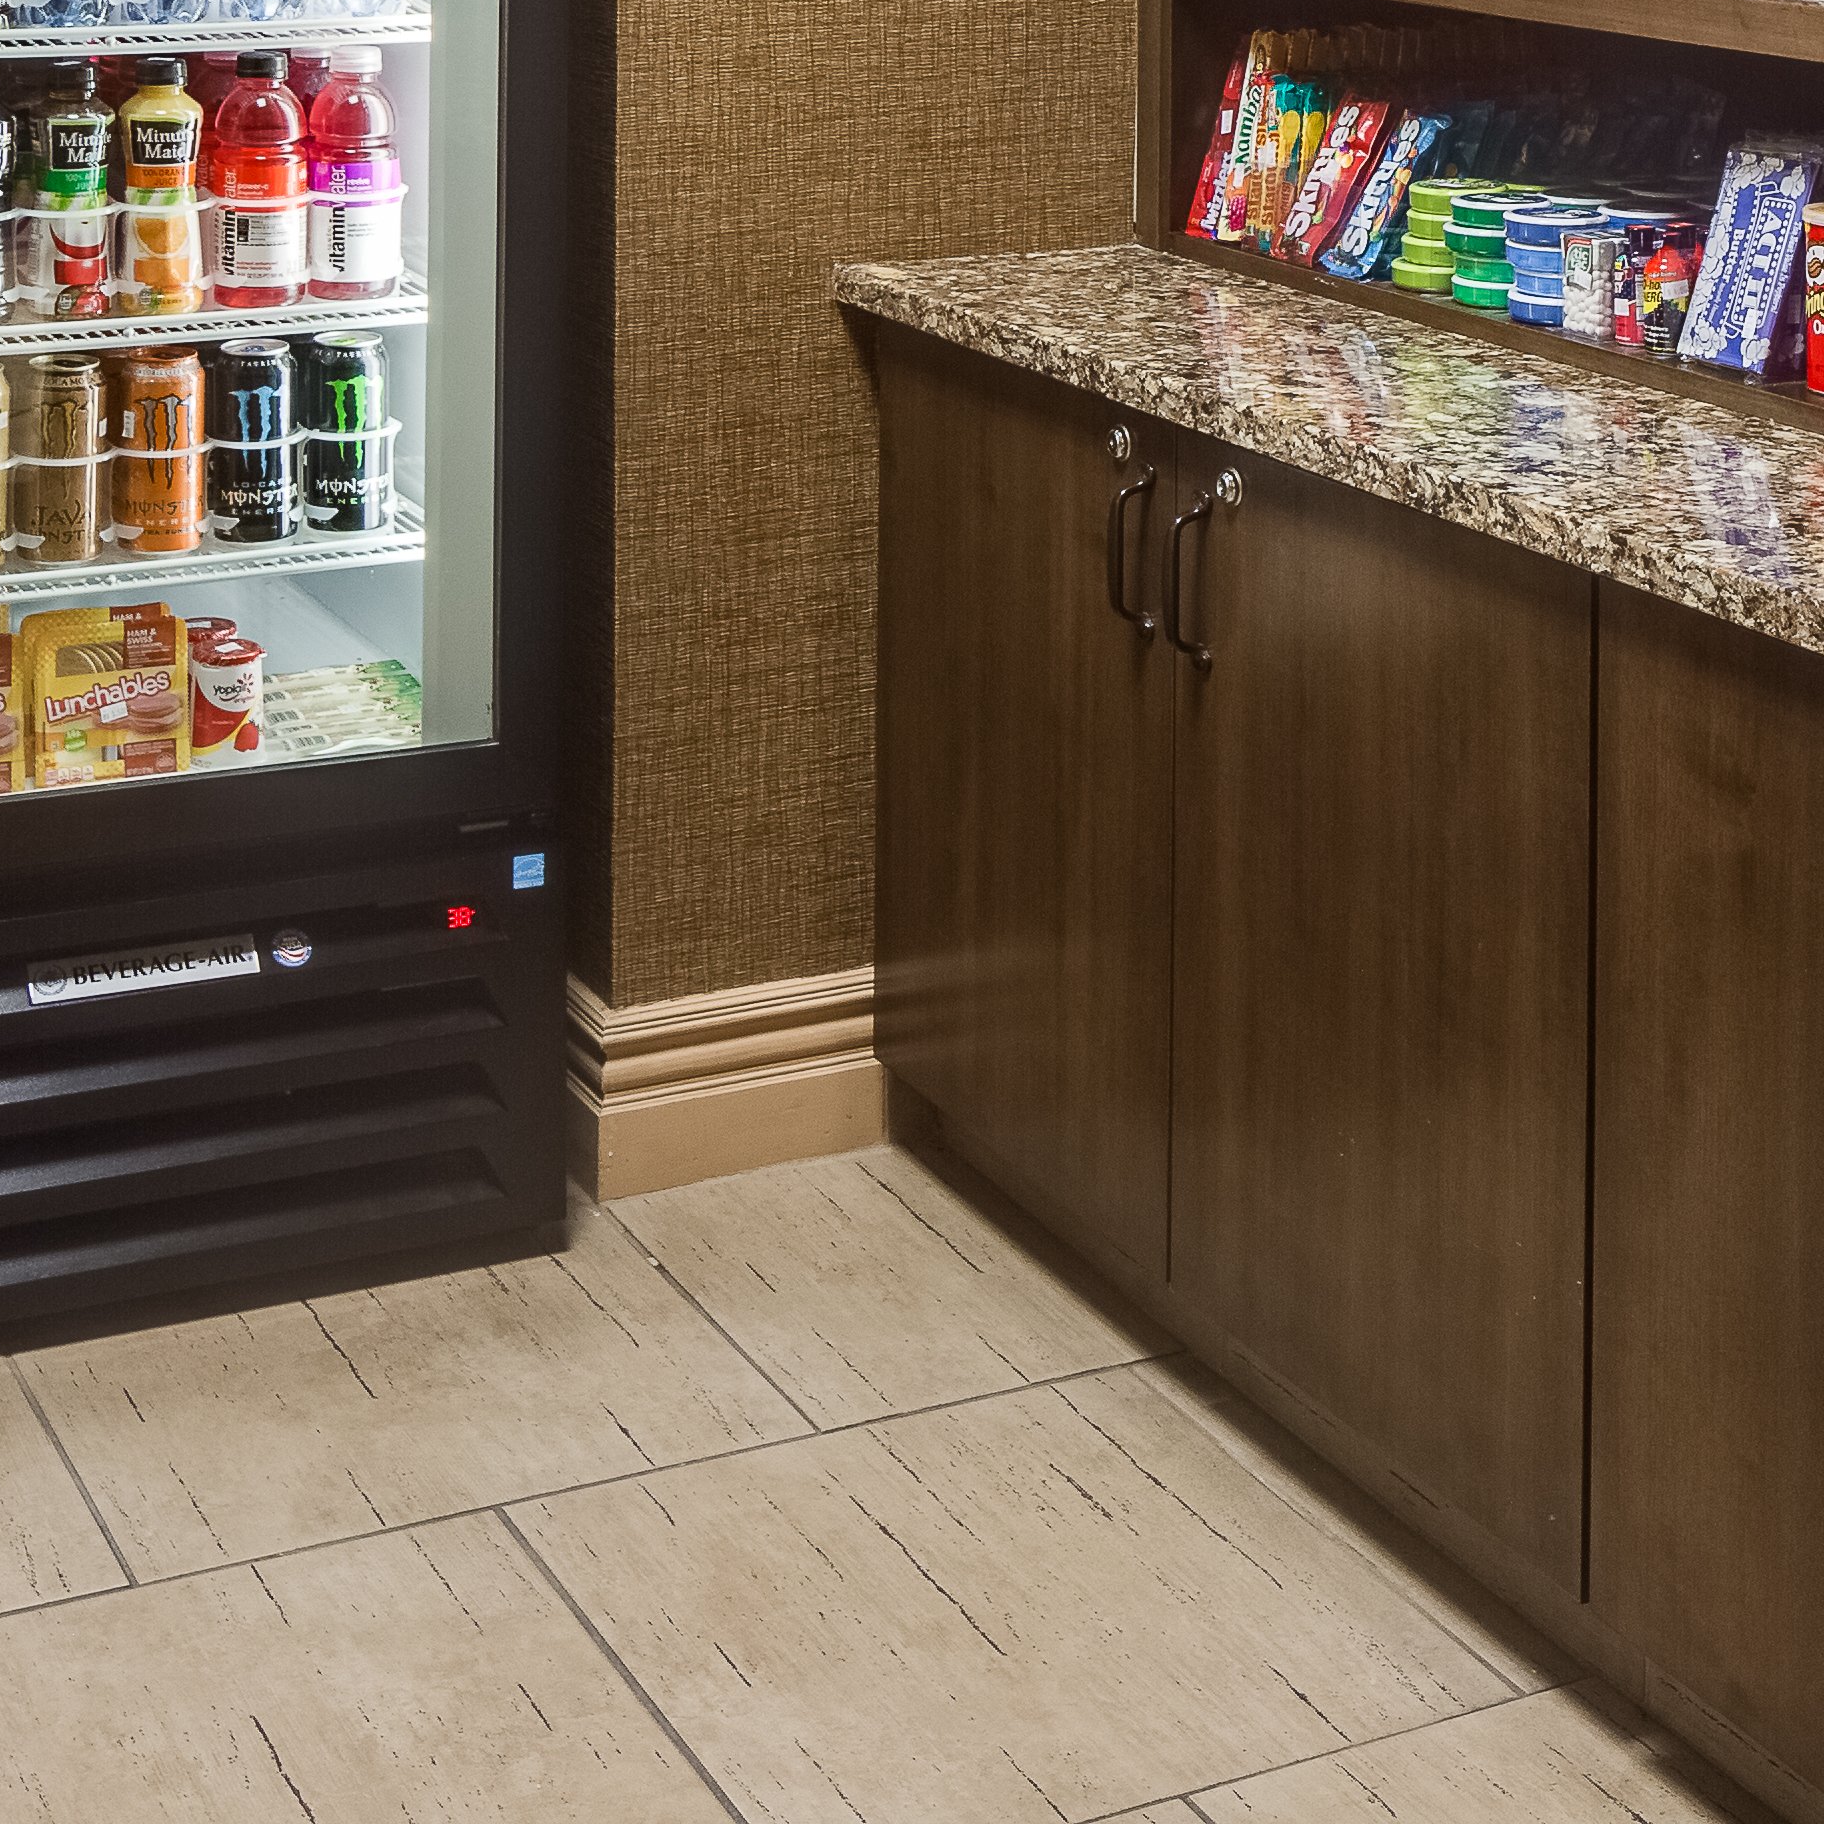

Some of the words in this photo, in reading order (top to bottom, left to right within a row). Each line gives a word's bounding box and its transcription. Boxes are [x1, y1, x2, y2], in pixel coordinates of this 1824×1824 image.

[136, 128, 194, 144] Minute
[144, 143, 186, 160] Maid
[1723, 229, 1745, 283] Butter
[1752, 210, 1782, 273] ACT
[447, 906, 471, 928] 38
[71, 946, 248, 987] BEVERAGE-AIR
